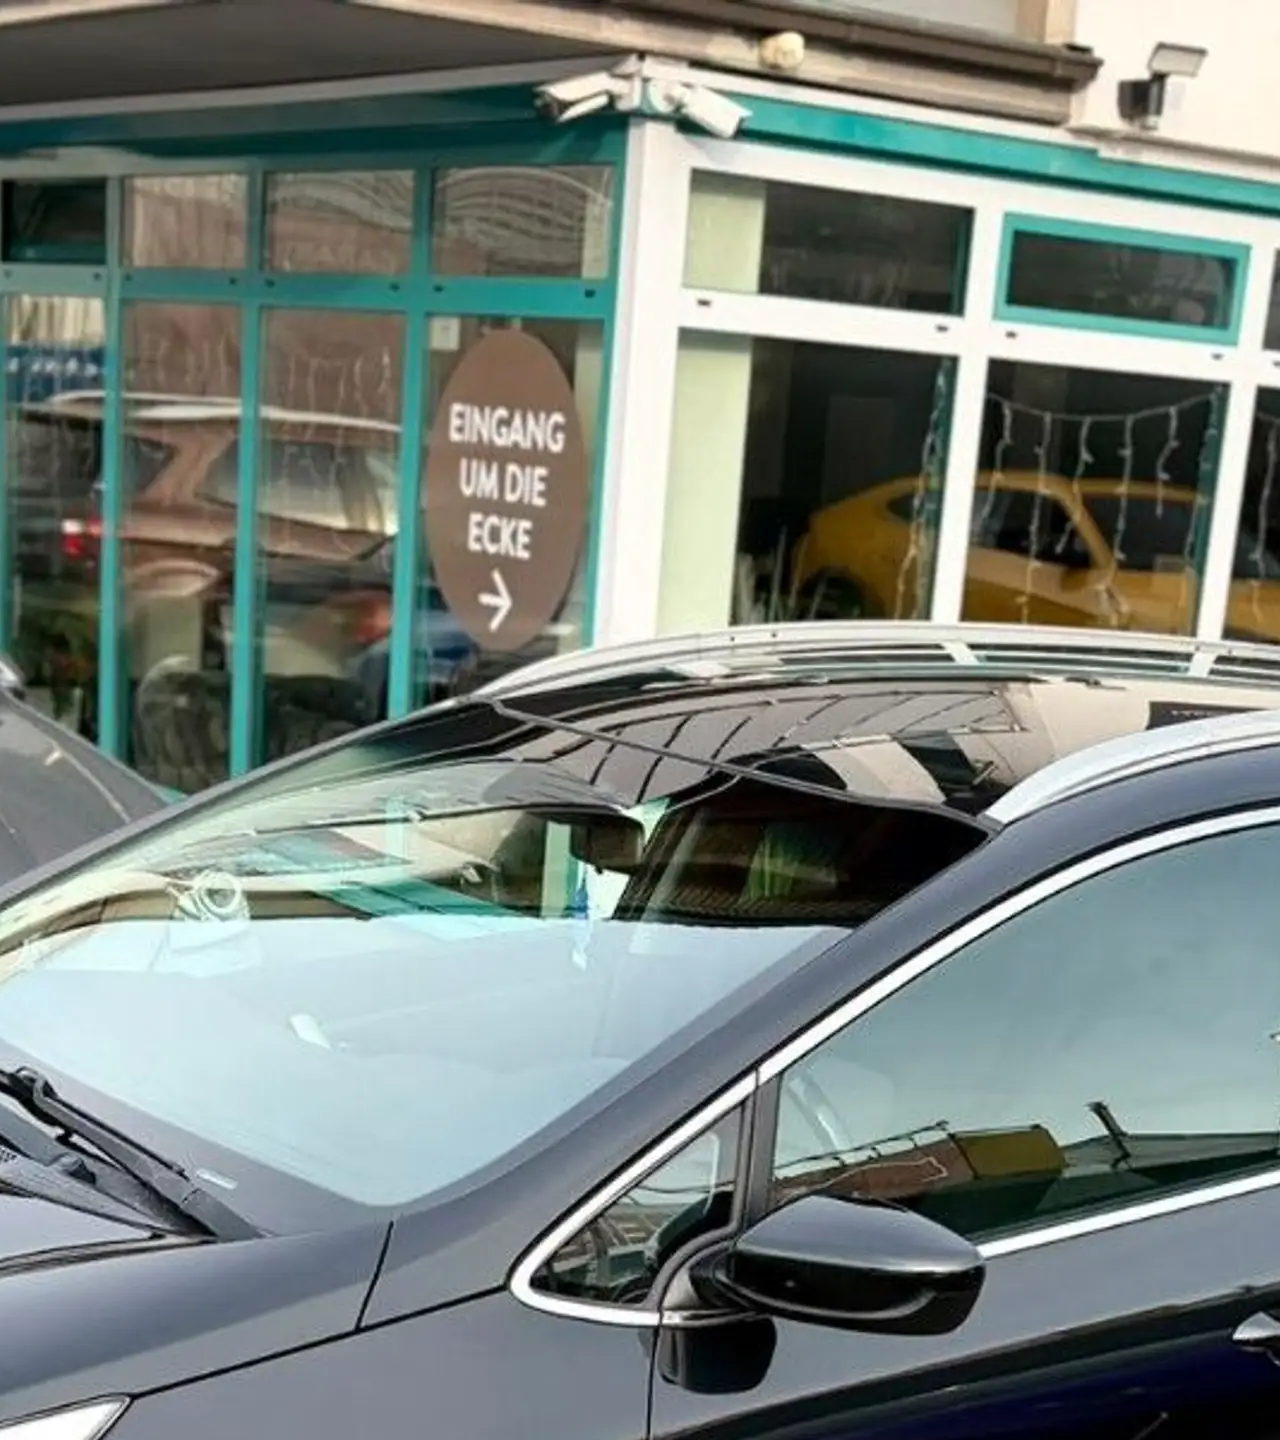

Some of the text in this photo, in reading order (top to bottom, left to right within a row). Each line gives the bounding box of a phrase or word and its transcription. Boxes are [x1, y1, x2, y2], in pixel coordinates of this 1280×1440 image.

[448, 402, 567, 454] EINGANG
[459, 459, 549, 507] UM DIE
[467, 514, 533, 560] ECKE
